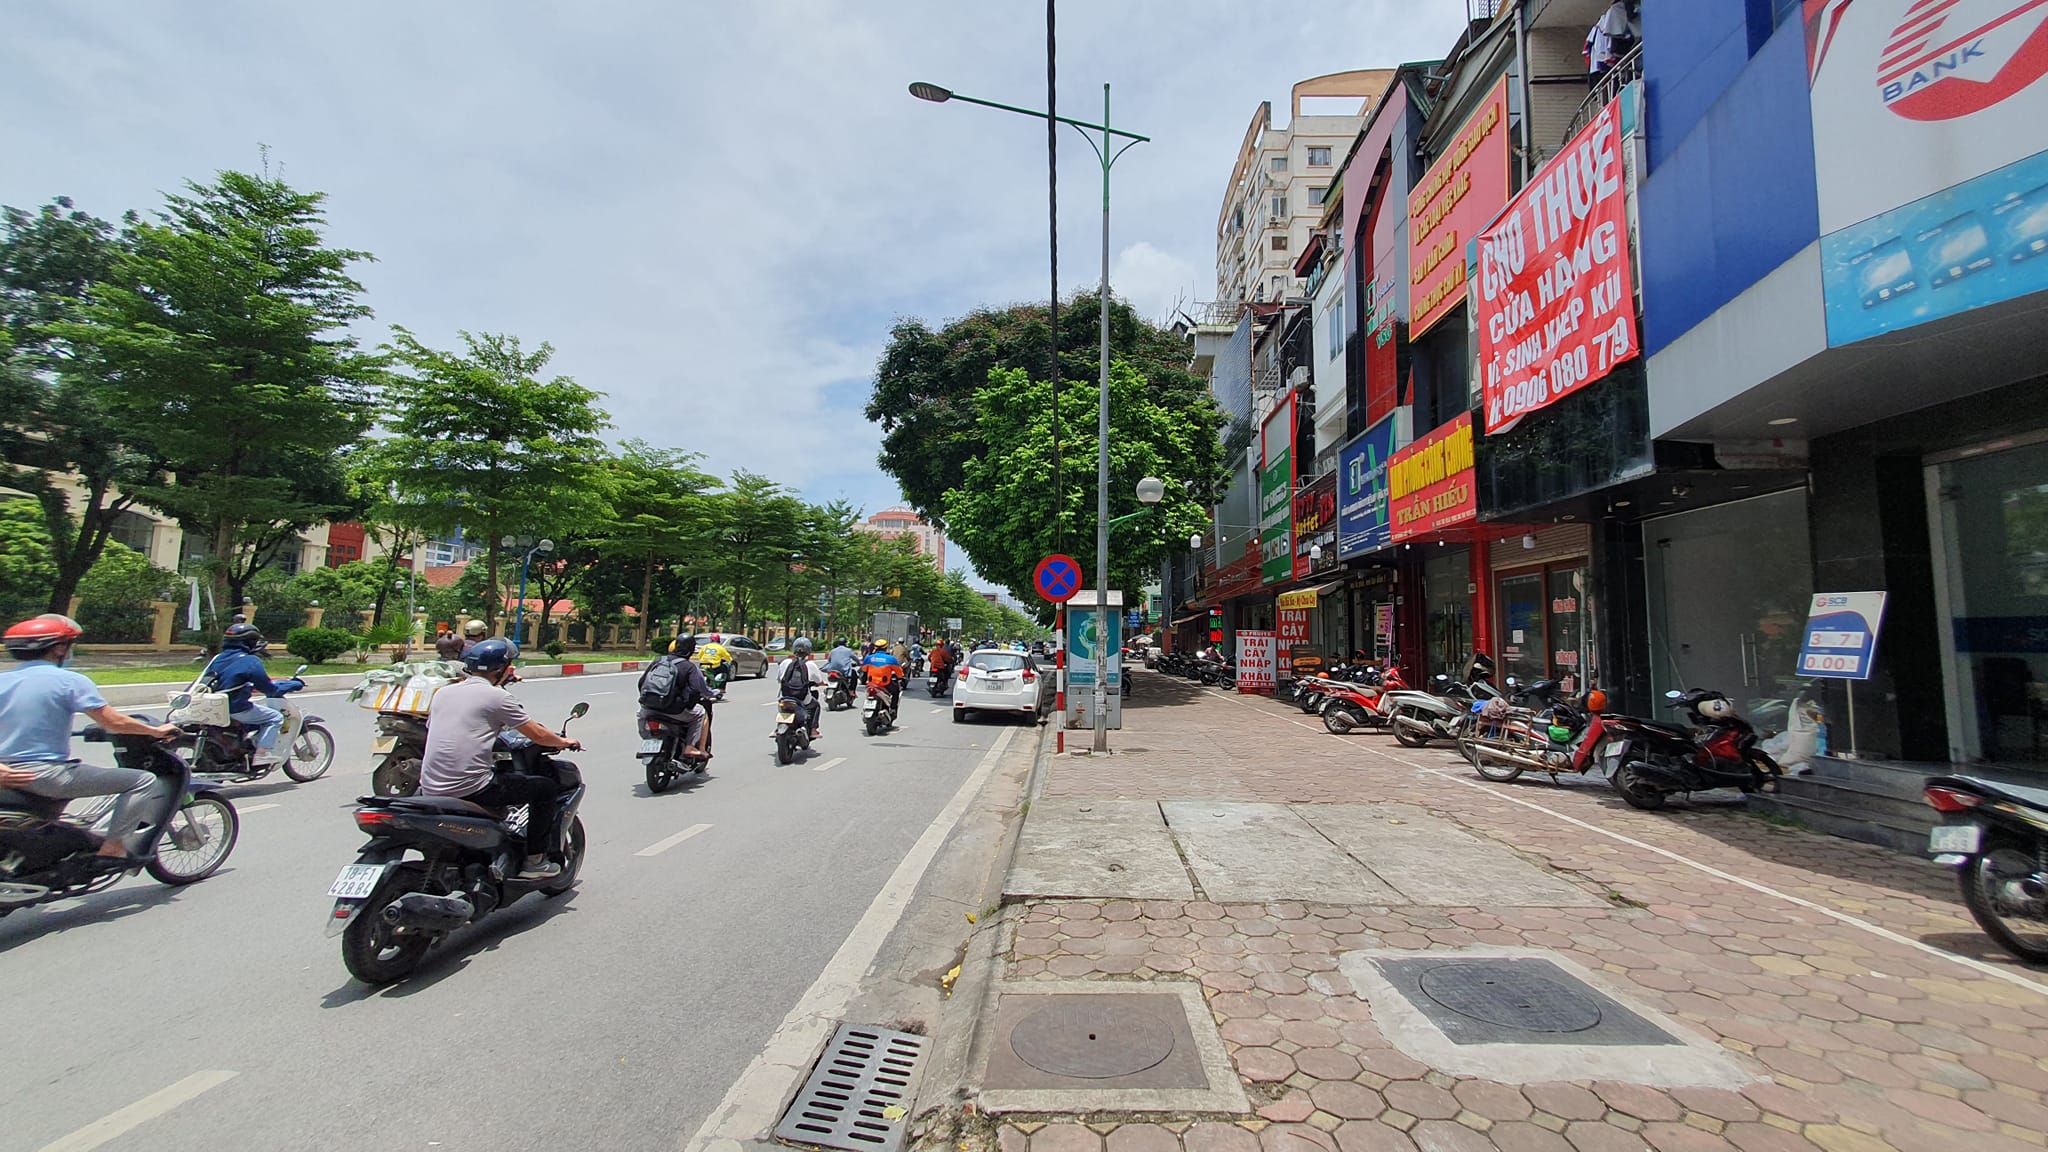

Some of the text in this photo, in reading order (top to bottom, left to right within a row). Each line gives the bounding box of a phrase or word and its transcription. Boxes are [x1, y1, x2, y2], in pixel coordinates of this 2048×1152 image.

[1882, 38, 1985, 103] BANK
[1481, 107, 1619, 303] CHO THUÊ
[1487, 220, 1617, 345] CỬA HÀNG
[1502, 370, 1549, 417] 0906
[1550, 344, 1589, 395] 080
[1591, 315, 1630, 371] 779
[1503, 328, 1543, 378] SINH
[1423, 437, 1445, 487] CÔNG
[1396, 494, 1431, 526] TRẦN
[1432, 478, 1469, 514] HIẾU
[1827, 596, 1848, 606] SCB
[1282, 623, 1304, 636] CÂY
[1240, 657, 1271, 669] NHẬP
[1244, 647, 1266, 657] CÂY
[1240, 669, 1271, 681] KHẨU
[330, 881, 370, 895] 428.84
[343, 866, 376, 880] 18-F1
